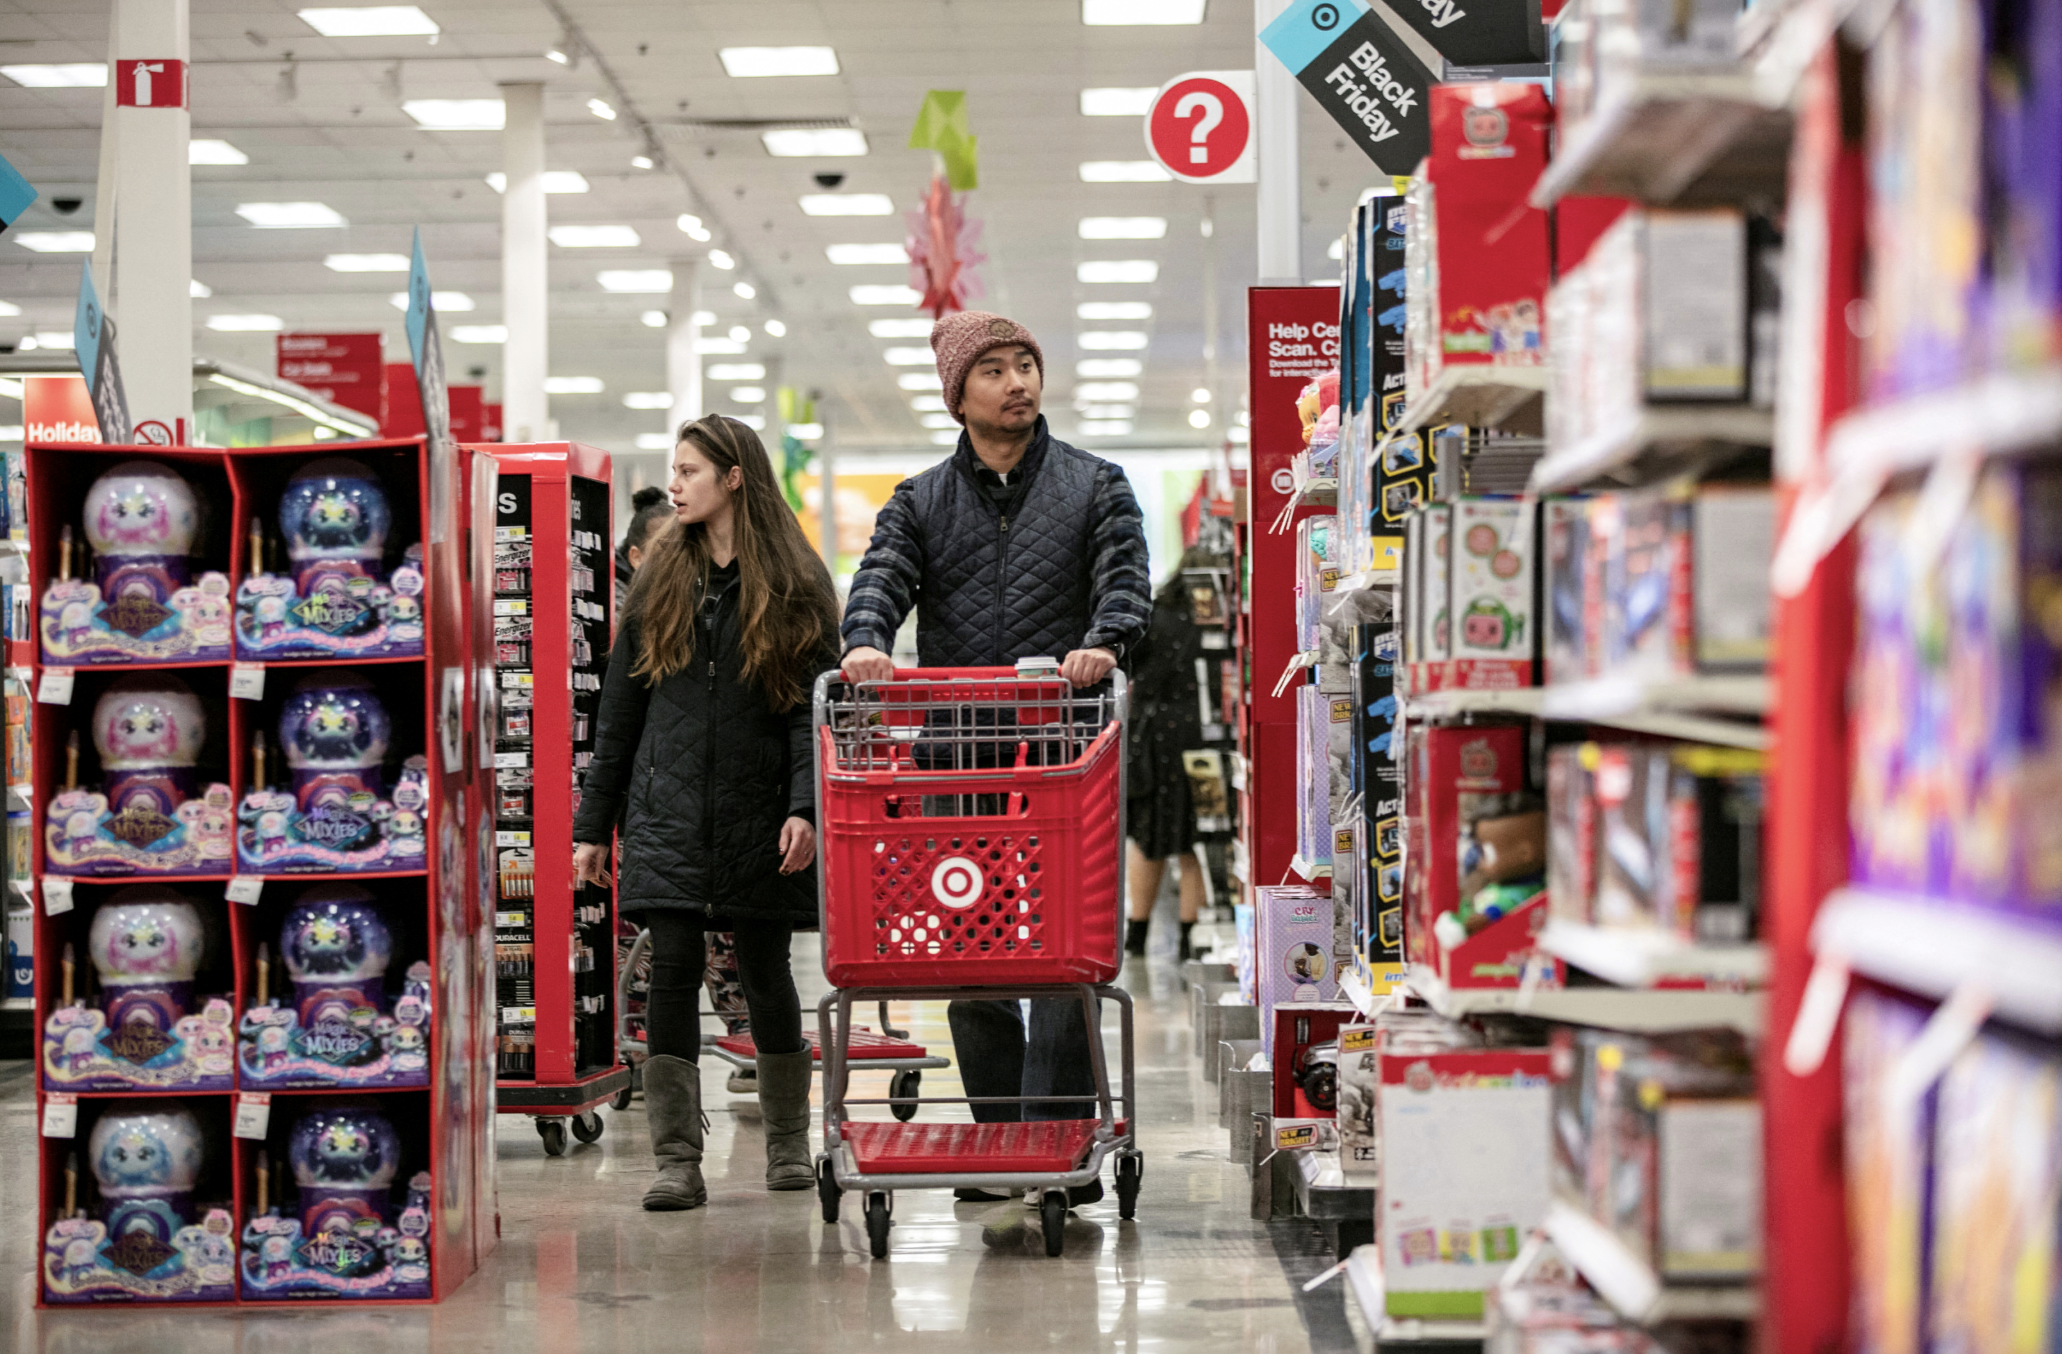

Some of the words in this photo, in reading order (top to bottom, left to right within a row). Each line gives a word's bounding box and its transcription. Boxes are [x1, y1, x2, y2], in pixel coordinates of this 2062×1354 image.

[1349, 41, 1418, 117] Black
[1325, 62, 1400, 142] Friday
[1269, 322, 1309, 341] Help
[1268, 340, 1318, 357] Scan.
[1269, 359, 1313, 368] Download
[1314, 359, 1329, 367] the
[28, 421, 102, 444] Holiday
[494, 549, 531, 563] Energizer
[495, 622, 532, 637] Energizer
[1279, 1129, 1298, 1139] NEW
